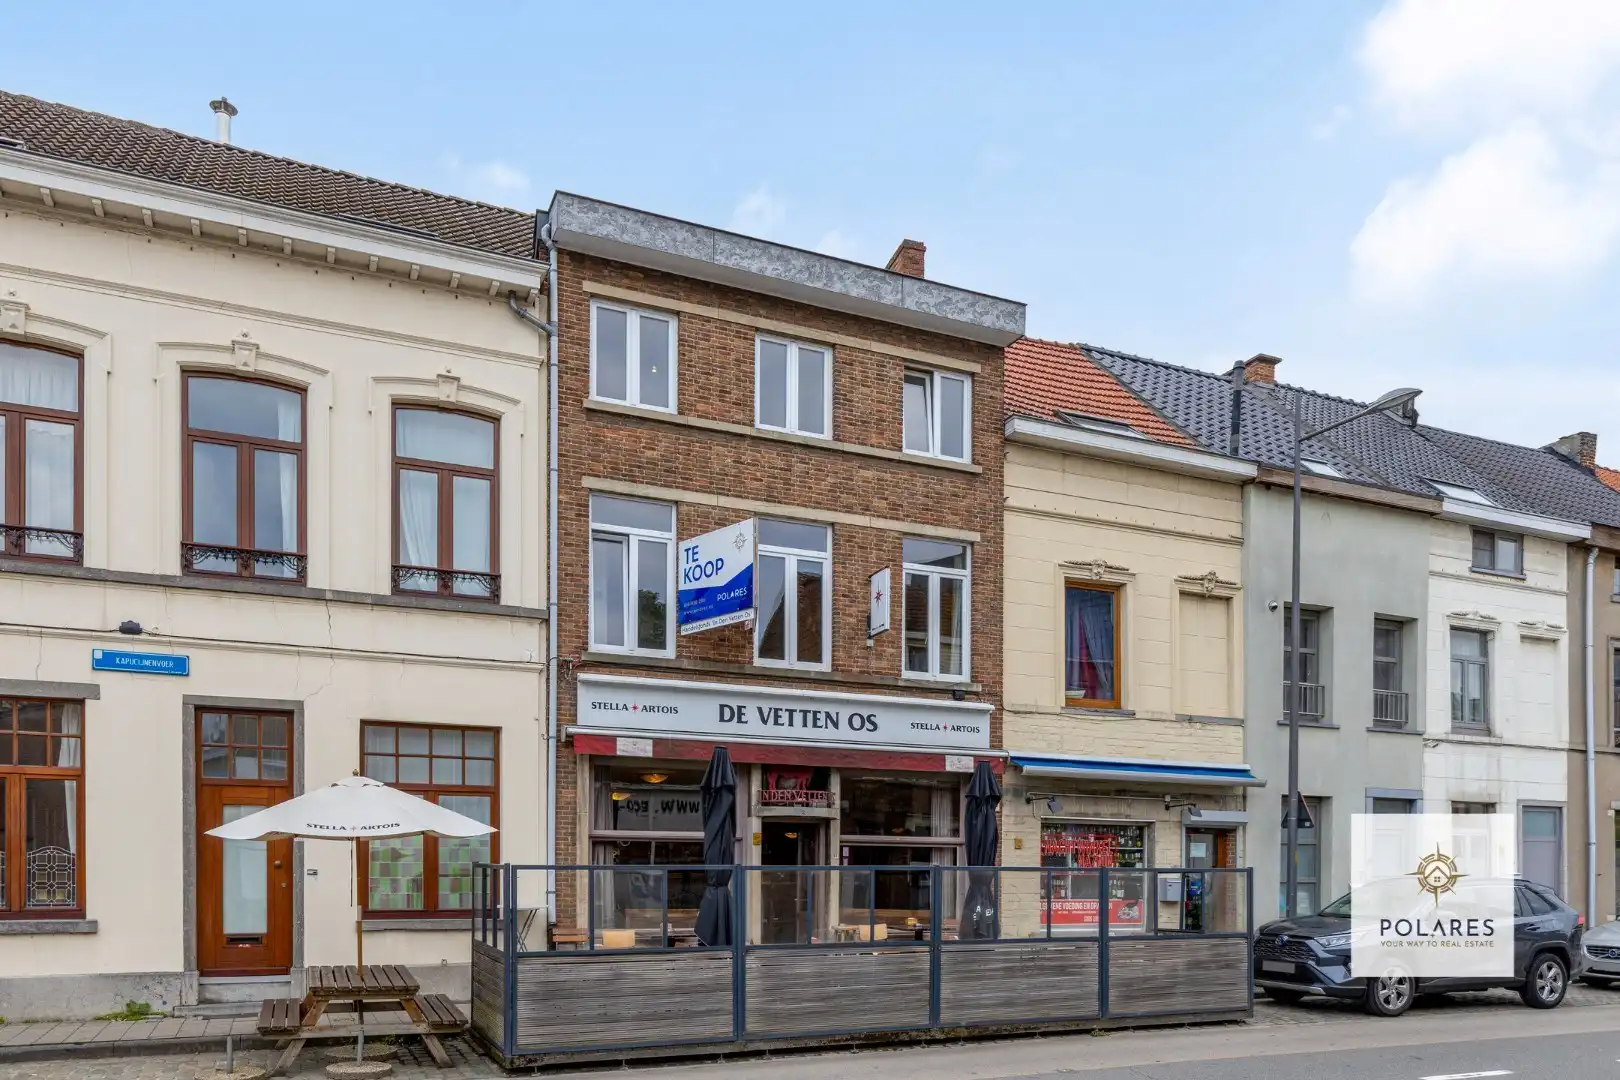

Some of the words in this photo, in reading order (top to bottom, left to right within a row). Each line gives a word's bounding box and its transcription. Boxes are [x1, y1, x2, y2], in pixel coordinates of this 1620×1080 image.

[684, 545, 699, 564] TE
[683, 558, 724, 584] KOOP
[717, 587, 747, 601] POLARES
[591, 701, 629, 711] STELLA
[641, 704, 679, 715] ARTOIS
[718, 703, 748, 725] DE
[756, 706, 840, 730] VETTEN
[848, 712, 878, 732] OS
[910, 722, 941, 731] STELLA
[950, 724, 981, 734] ARTOIS
[306, 823, 347, 831] STELLA
[360, 822, 400, 831] ARTOIS
